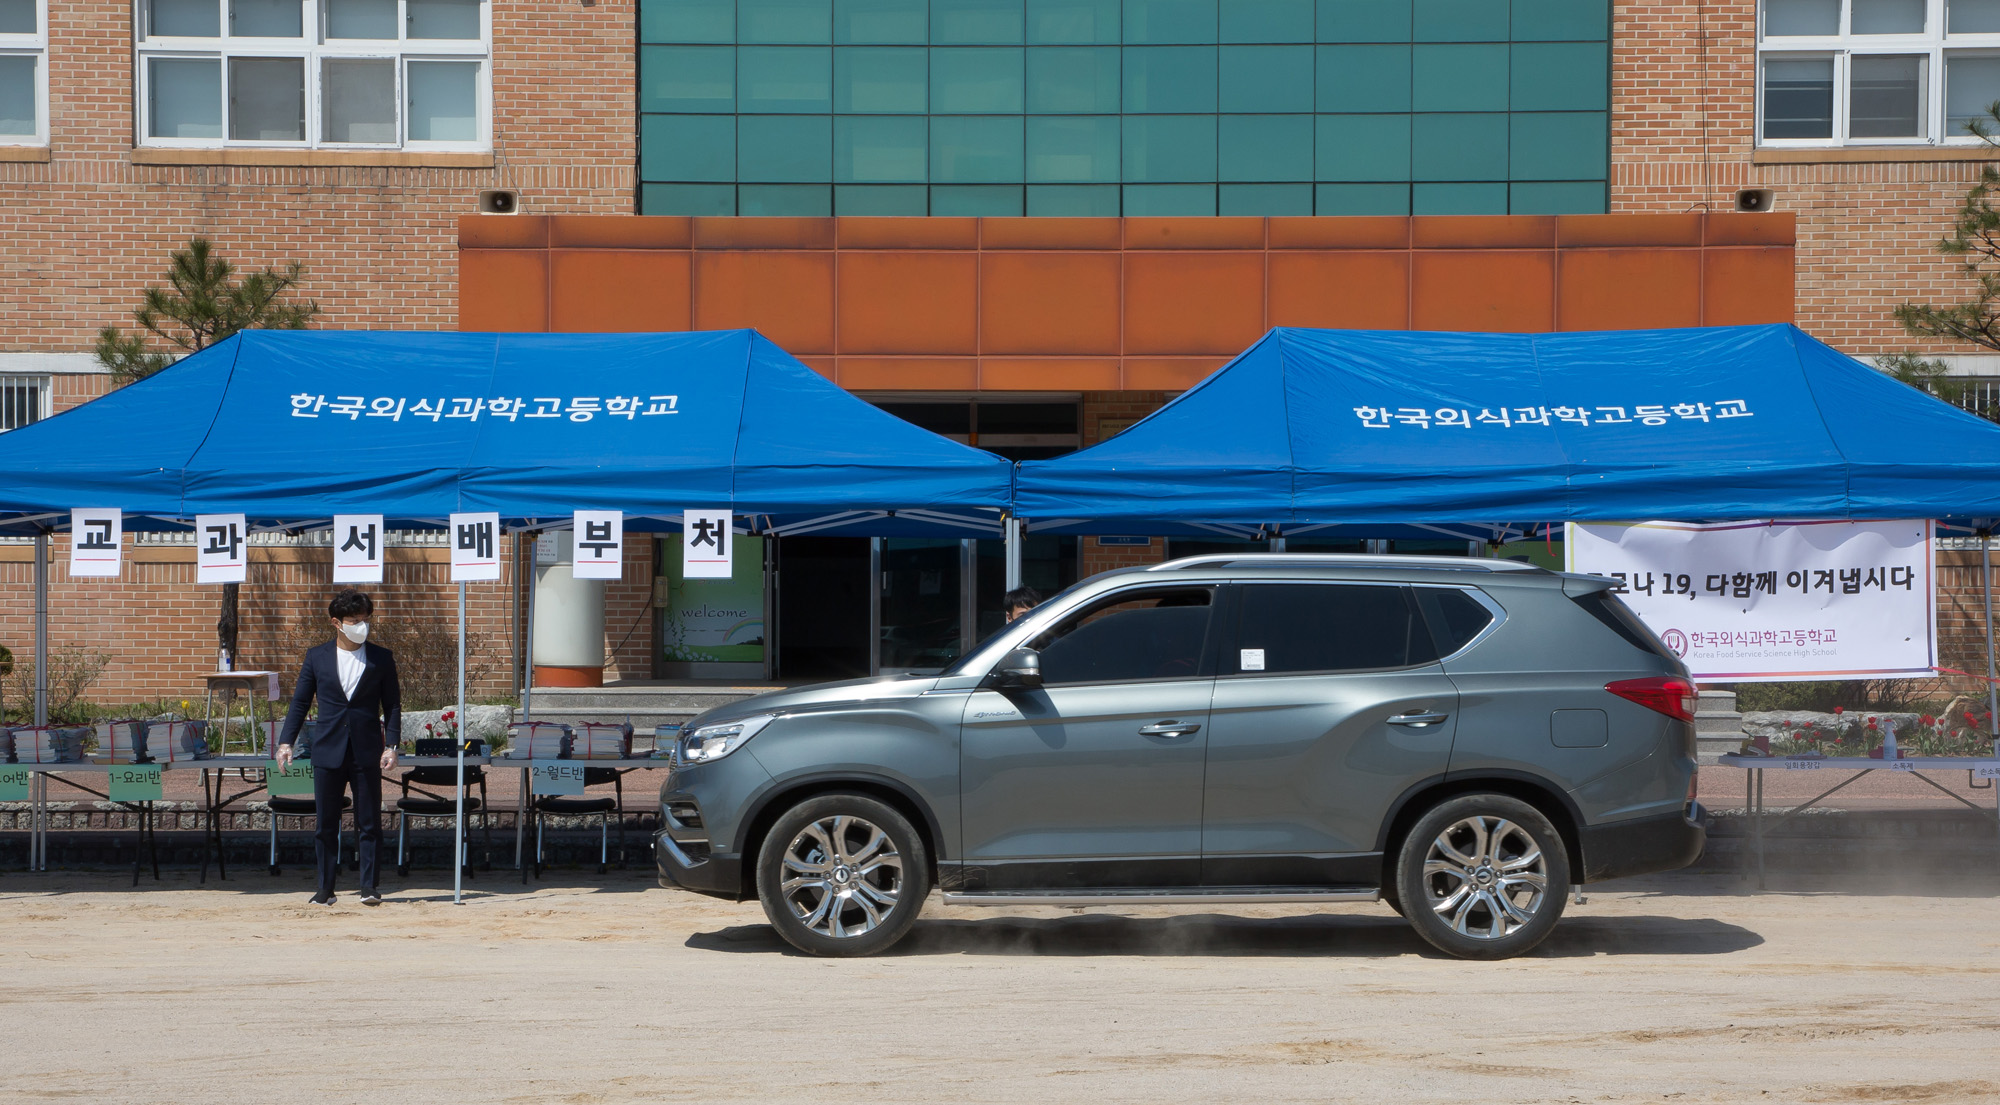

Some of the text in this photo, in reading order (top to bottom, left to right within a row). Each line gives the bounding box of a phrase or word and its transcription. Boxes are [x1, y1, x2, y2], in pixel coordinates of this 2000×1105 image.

[290, 392, 679, 423] 한국외식과학고등학교
[1353, 399, 1754, 429] 한국외식과학고등학교
[77, 519, 117, 550] 교
[203, 523, 243, 560] 과
[340, 523, 376, 561] 서
[457, 521, 493, 559] 배
[579, 520, 618, 558] 부
[690, 518, 725, 556] 처
[1587, 565, 1915, 601] 로나 19, 다함께 이겨냅시다
[682, 604, 747, 618] welcome
[1690, 628, 1838, 648] 한국외식과학고등학교
[1693, 648, 1837, 659] Korea Food Service Science High School
[109, 770, 161, 785] 1-요리반
[532, 765, 584, 781] 2-월드반
[1892, 761, 1914, 771] 소독제
